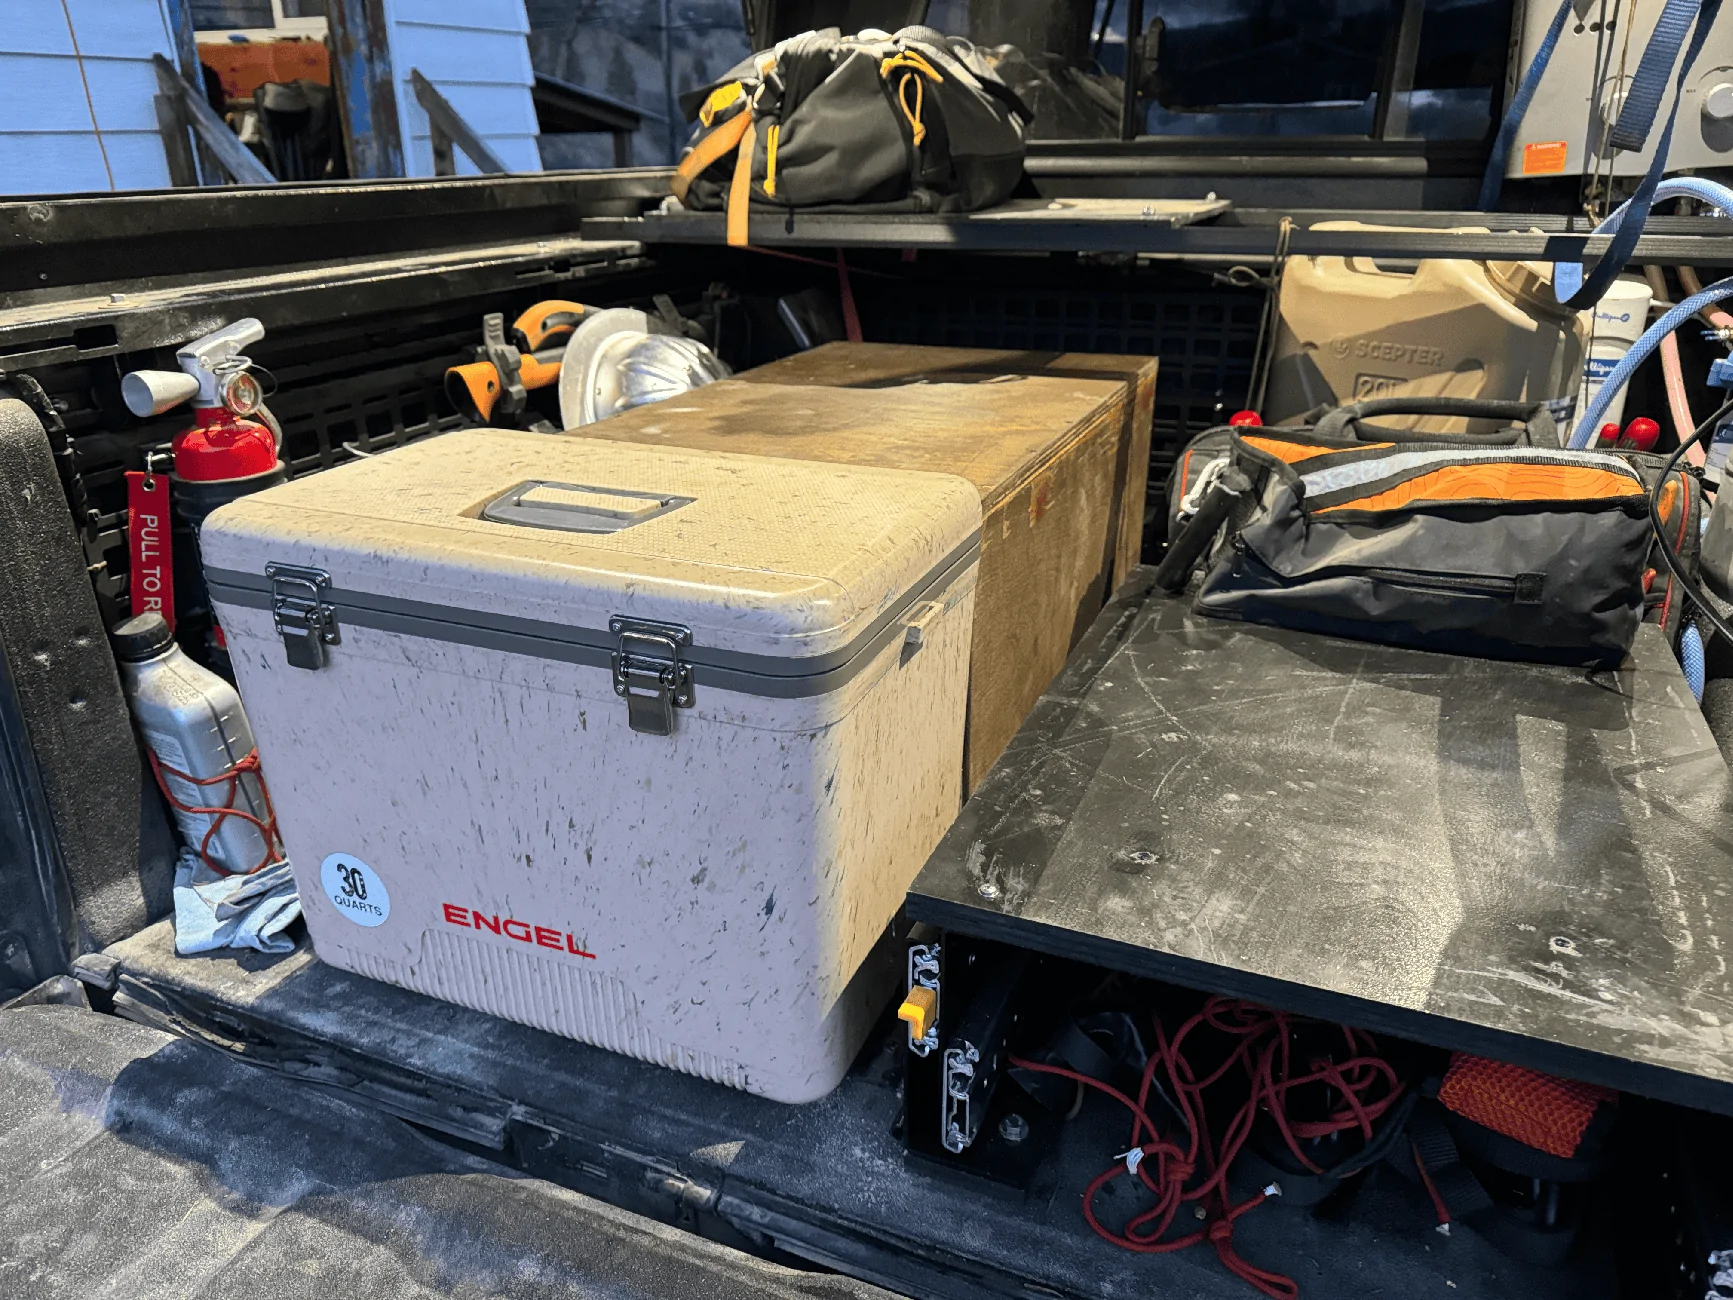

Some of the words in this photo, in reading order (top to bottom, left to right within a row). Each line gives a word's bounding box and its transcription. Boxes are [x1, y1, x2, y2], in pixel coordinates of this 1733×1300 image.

[1355, 339, 1444, 367] SCEPTER
[139, 514, 160, 562] PULL
[141, 565, 162, 592] TO
[336, 863, 368, 901] 30
[334, 895, 383, 917] QUARTS
[442, 902, 597, 960] ENGEL
